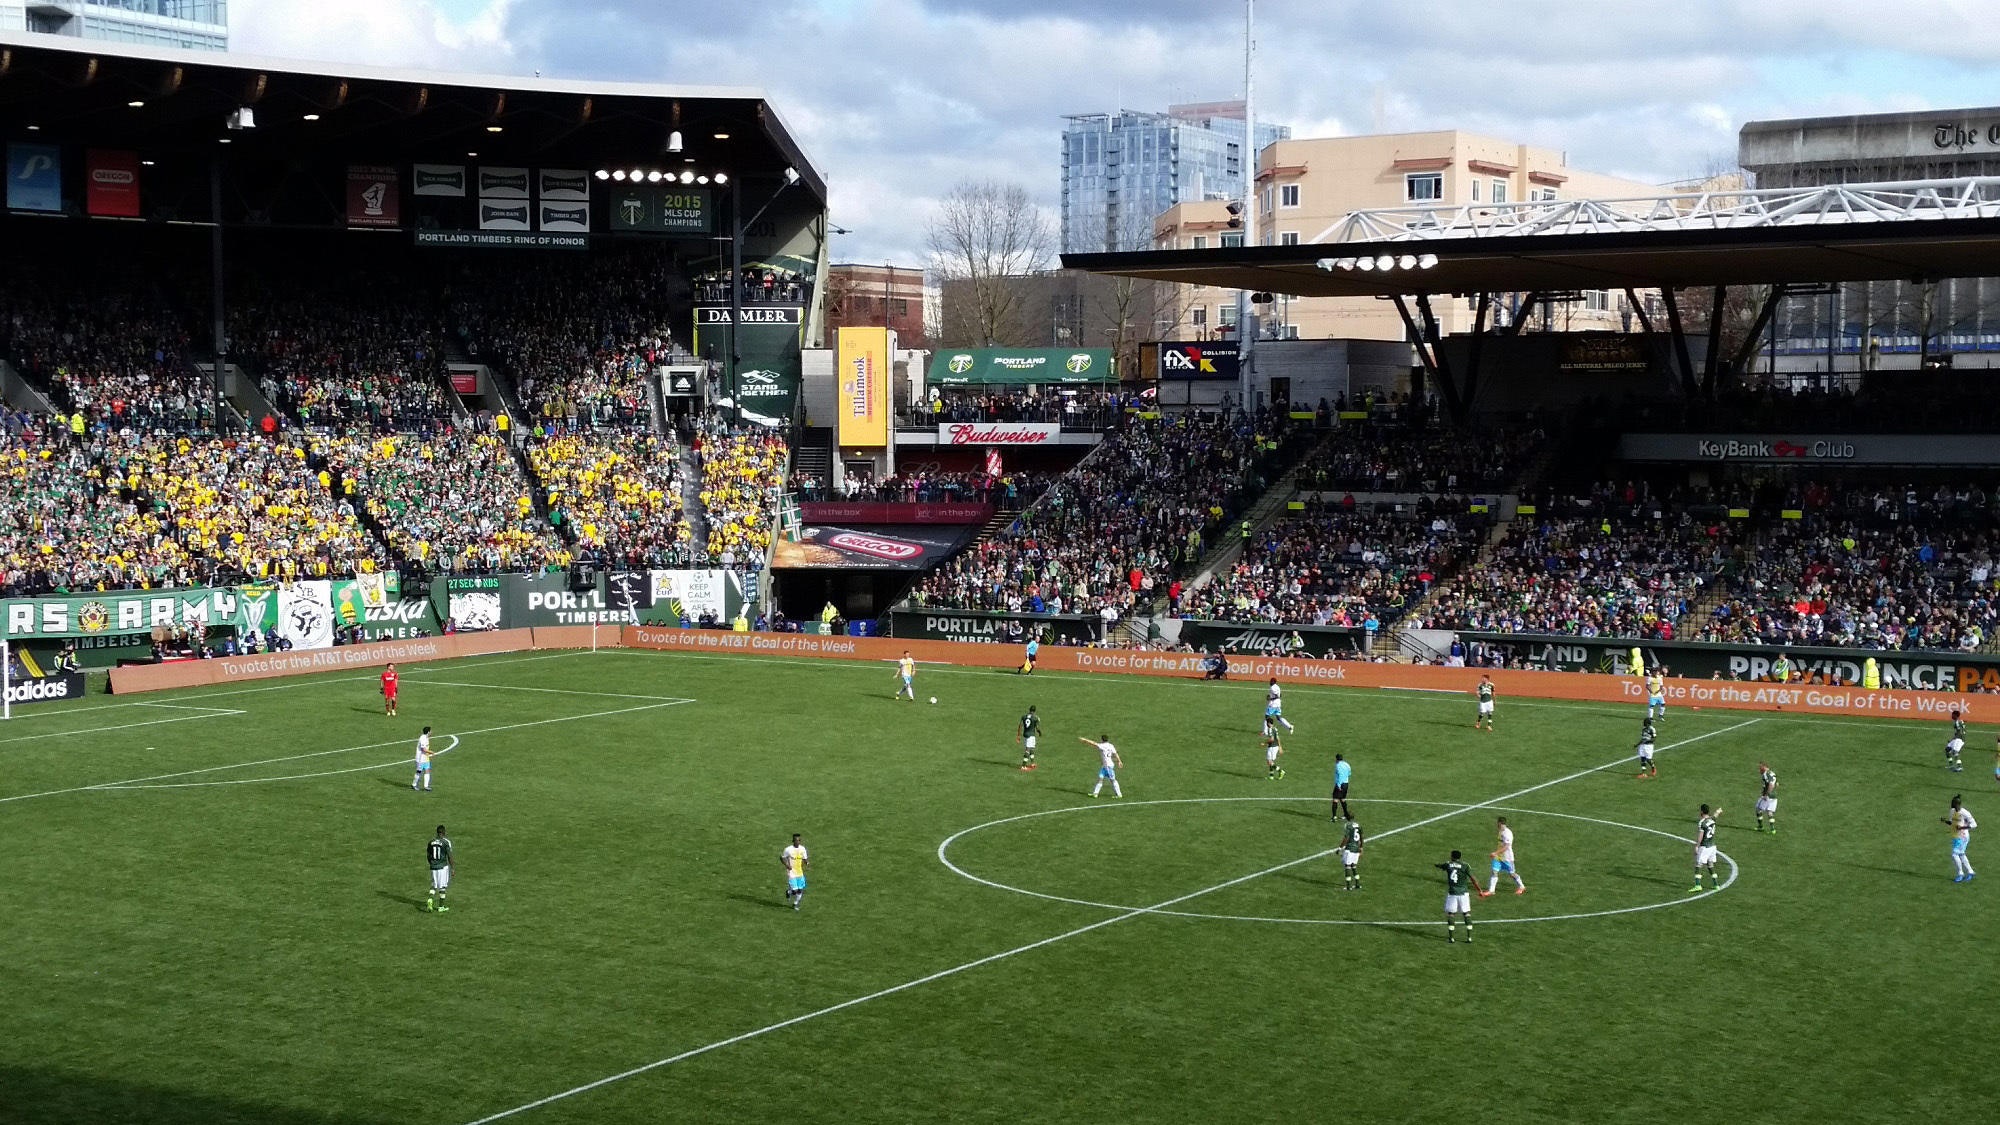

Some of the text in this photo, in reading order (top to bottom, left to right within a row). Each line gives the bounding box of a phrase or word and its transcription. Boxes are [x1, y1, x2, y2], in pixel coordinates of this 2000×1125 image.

[1934, 123, 1978, 151] The
[664, 194, 702, 208] 2015
[664, 209, 701, 218] MLS CUP
[664, 218, 702, 227] CHAMPIONS
[418, 233, 585, 246] PORTLAND TIMBERS RING OF HONOR
[708, 310, 788, 322] DAMLER
[993, 357, 1047, 365] PORTLAND
[1163, 350, 1196, 369] fix
[853, 356, 865, 416] Tillamook
[948, 423, 1049, 444] Budweiser
[1699, 440, 1855, 460] KeyBank Club
[838, 536, 910, 555] OREGON
[448, 578, 499, 589] 27 SECNDS
[529, 591, 606, 610] PORTL
[8, 603, 68, 634] RS
[118, 591, 237, 629] ARMY
[366, 598, 428, 624] aska
[556, 611, 630, 623] TIMBERS
[364, 627, 418, 640] LINES
[926, 617, 1018, 634] PORTLA
[62, 634, 141, 649] TIMBERS
[636, 630, 856, 653] To vote for the AT&T Goal of the Week
[221, 642, 438, 675] To vote for the AT&T Goal of the Week
[1076, 652, 1346, 679] To vote for the AT& oal of the Week
[1730, 656, 1956, 690] PROVIDNCE
[3, 680, 67, 701] adidas
[1621, 681, 1971, 714] To ote for the AT&T Goal of the Week
[1025, 718, 1031, 728] 9
[432, 846, 441, 859] 11
[1450, 869, 1458, 883] 4
